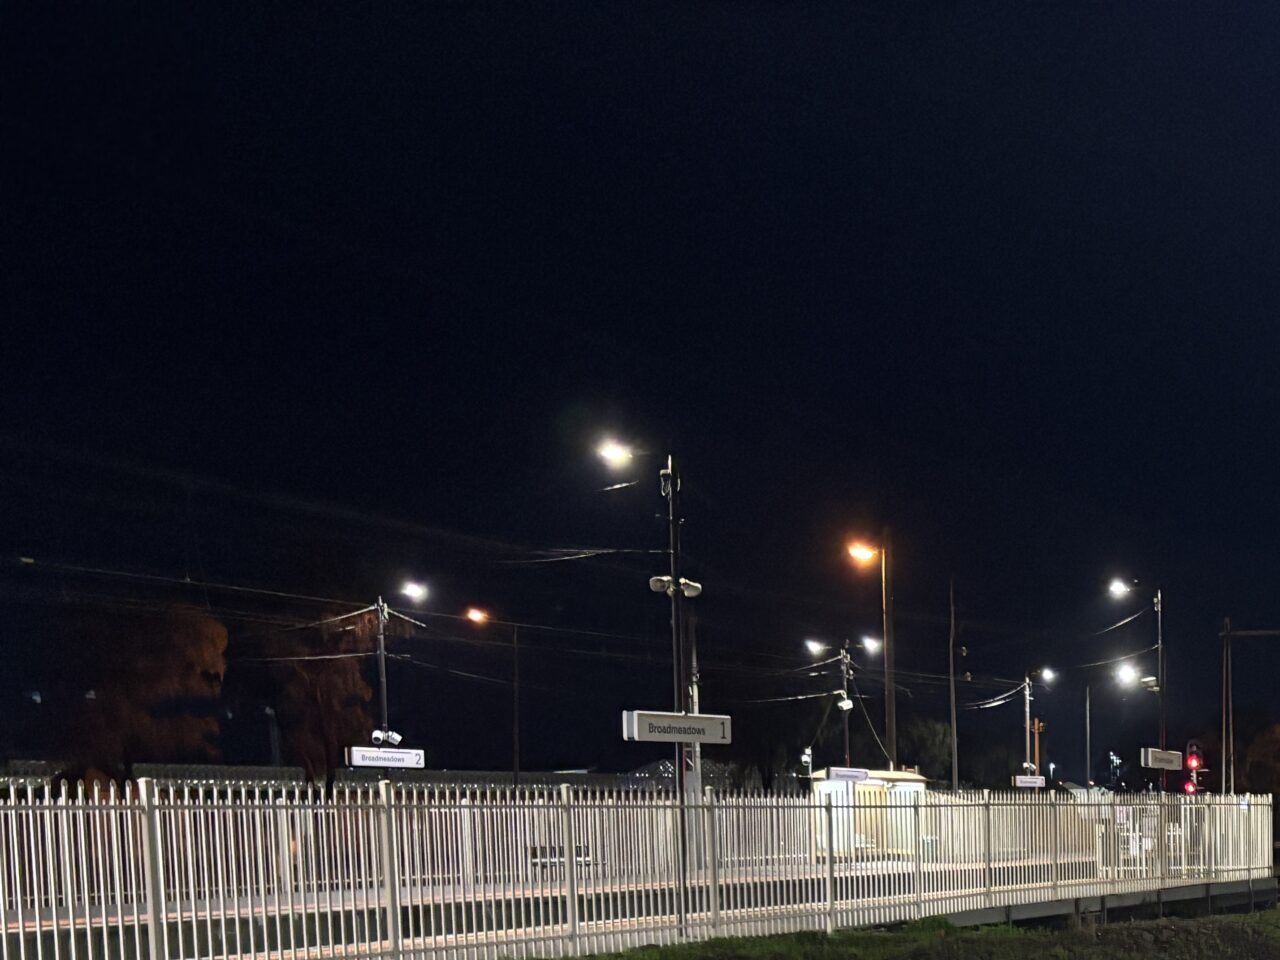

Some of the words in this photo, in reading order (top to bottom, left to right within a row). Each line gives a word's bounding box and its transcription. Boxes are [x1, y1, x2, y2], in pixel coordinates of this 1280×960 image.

[648, 722, 706, 736] Broadmeadows
[720, 721, 727, 739] 1
[415, 753, 422, 765] 2
